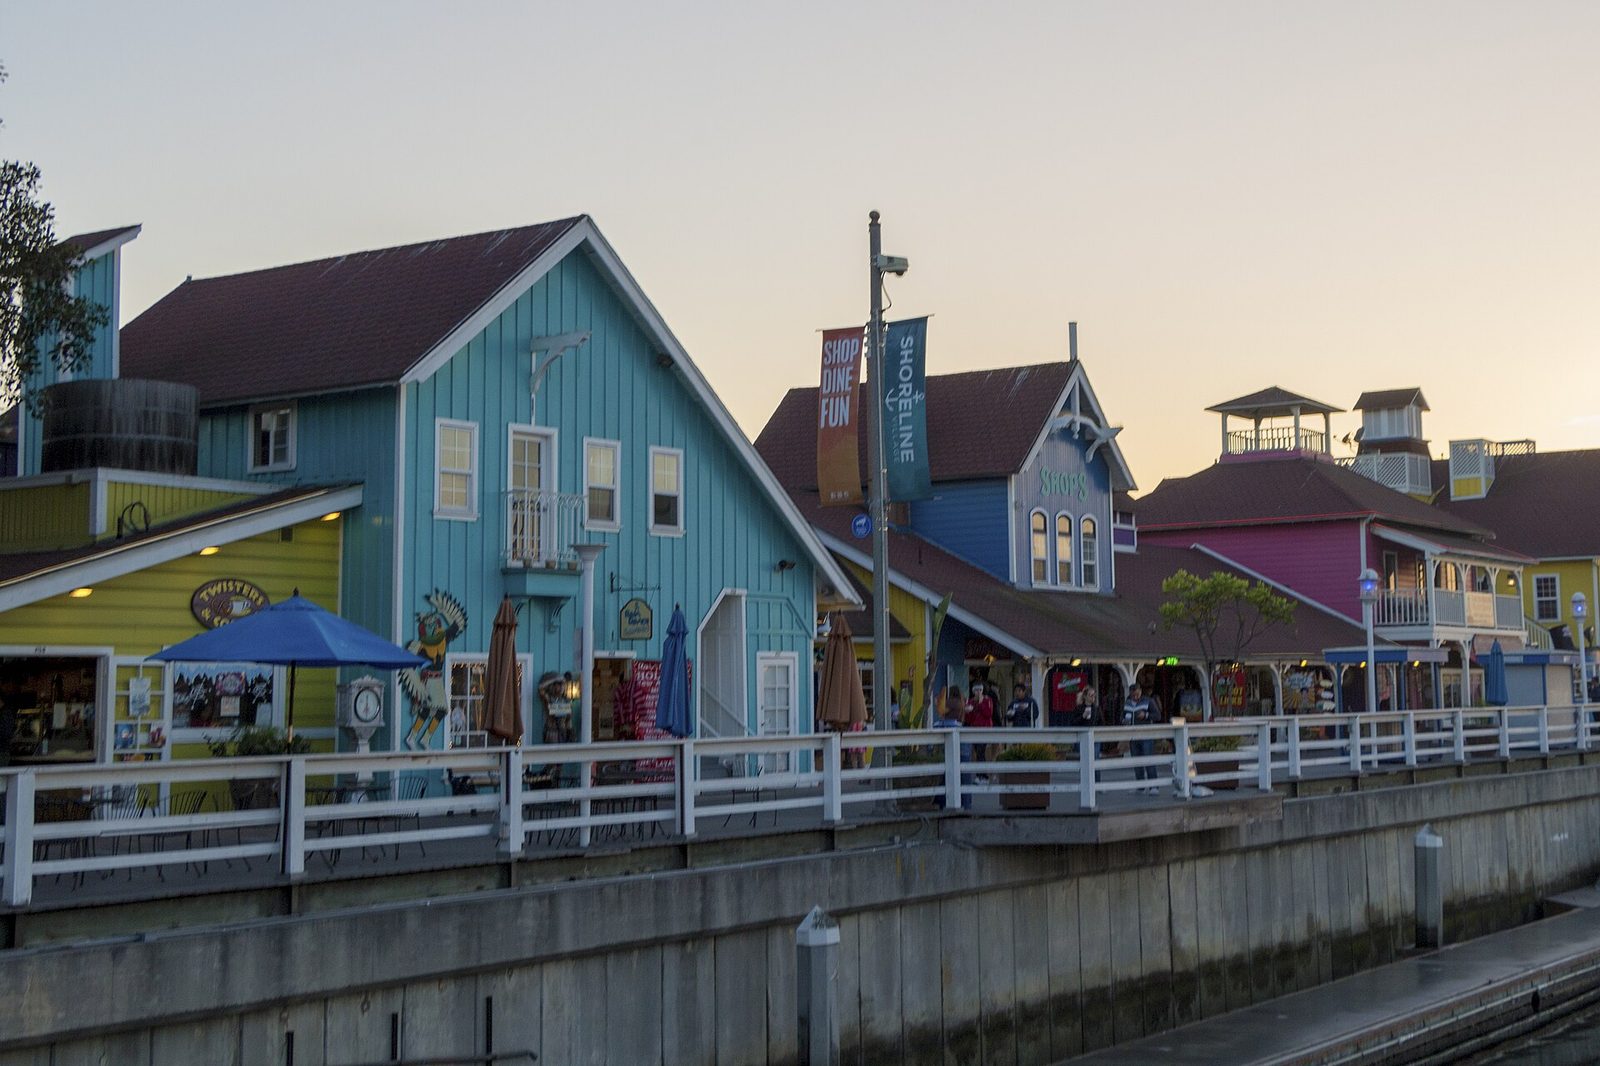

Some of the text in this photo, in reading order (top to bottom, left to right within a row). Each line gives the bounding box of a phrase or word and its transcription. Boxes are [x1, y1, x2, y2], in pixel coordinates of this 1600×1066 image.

[824, 337, 859, 365] SHOP
[822, 366, 853, 395] DINE
[820, 395, 851, 430] FUN
[898, 336, 914, 463] SHORELINE
[892, 416, 901, 464] VILLAGE
[199, 580, 264, 606] TWISTERS
[201, 607, 211, 622] &
